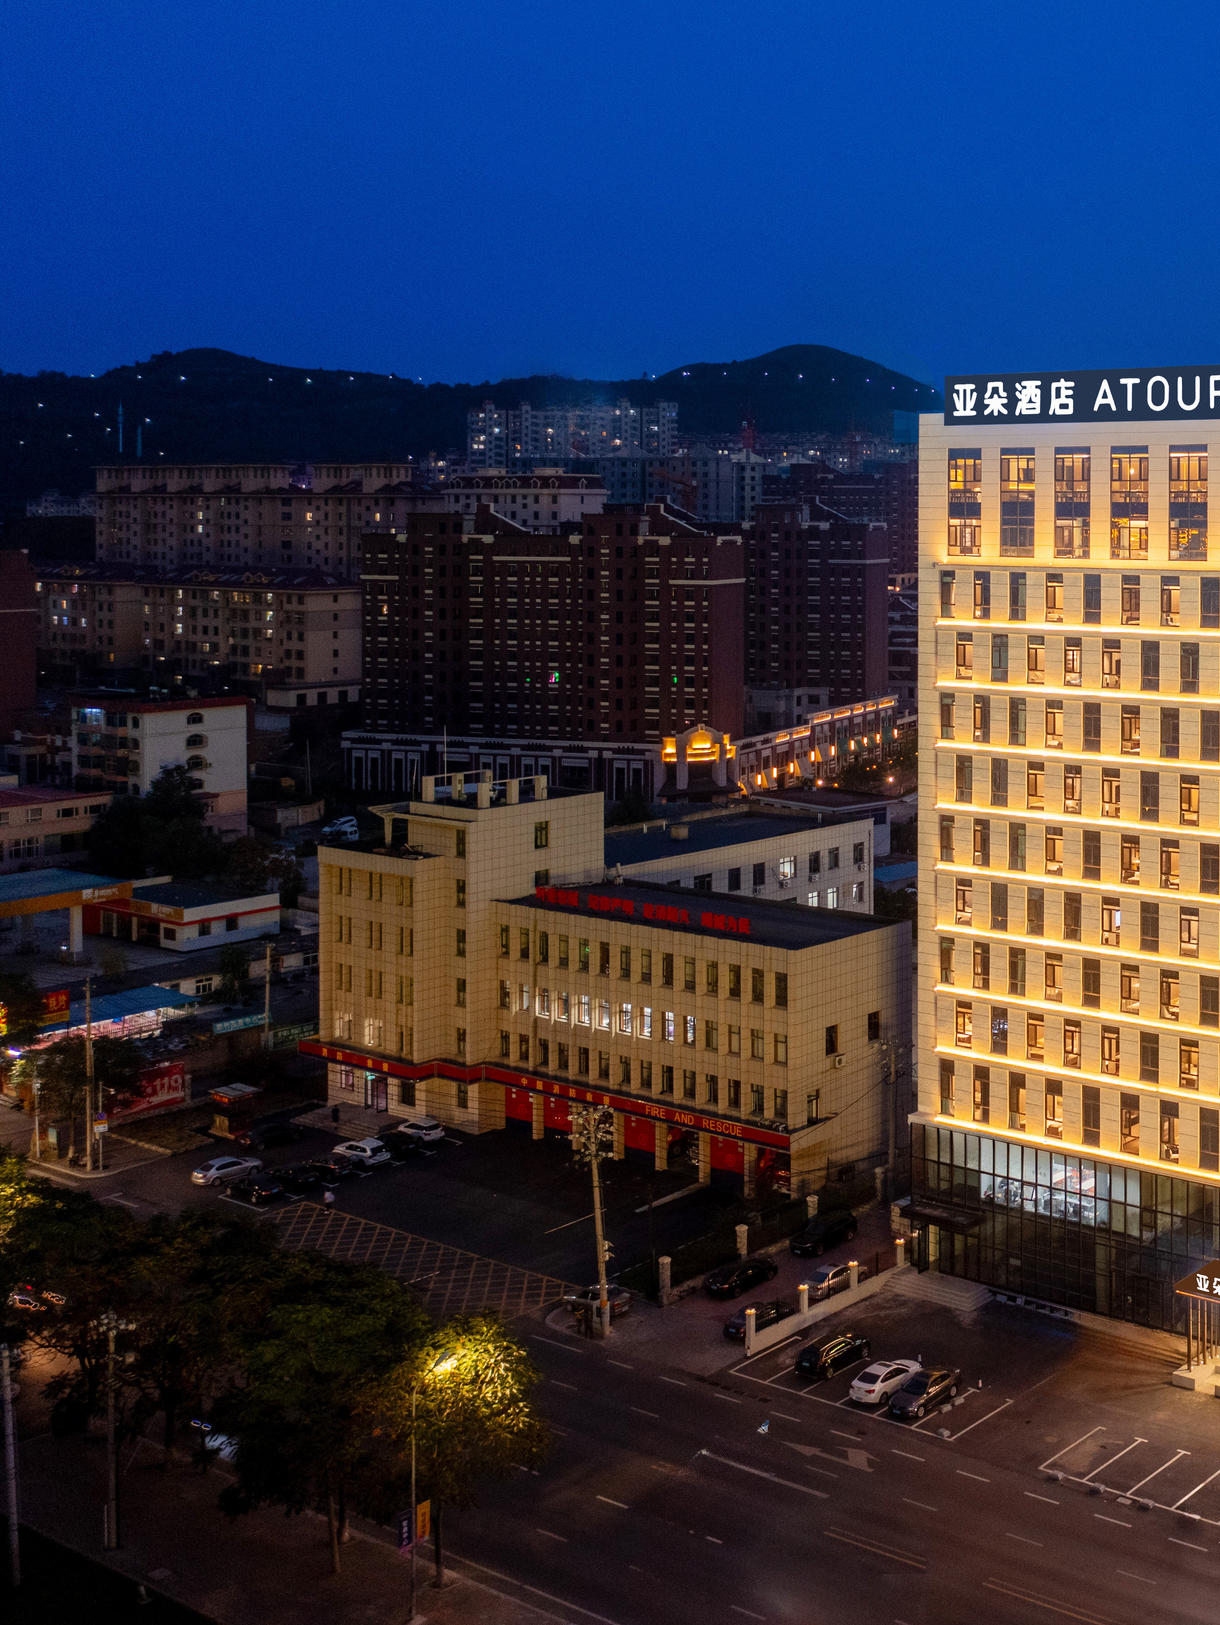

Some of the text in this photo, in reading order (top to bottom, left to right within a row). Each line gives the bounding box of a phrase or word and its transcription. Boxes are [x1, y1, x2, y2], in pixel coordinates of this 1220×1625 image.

[953, 379, 1075, 417] 亚朵酒店
[645, 1105, 666, 1119] FIRE
[674, 1112, 695, 1125] AND
[702, 1118, 743, 1137] RESCUE
